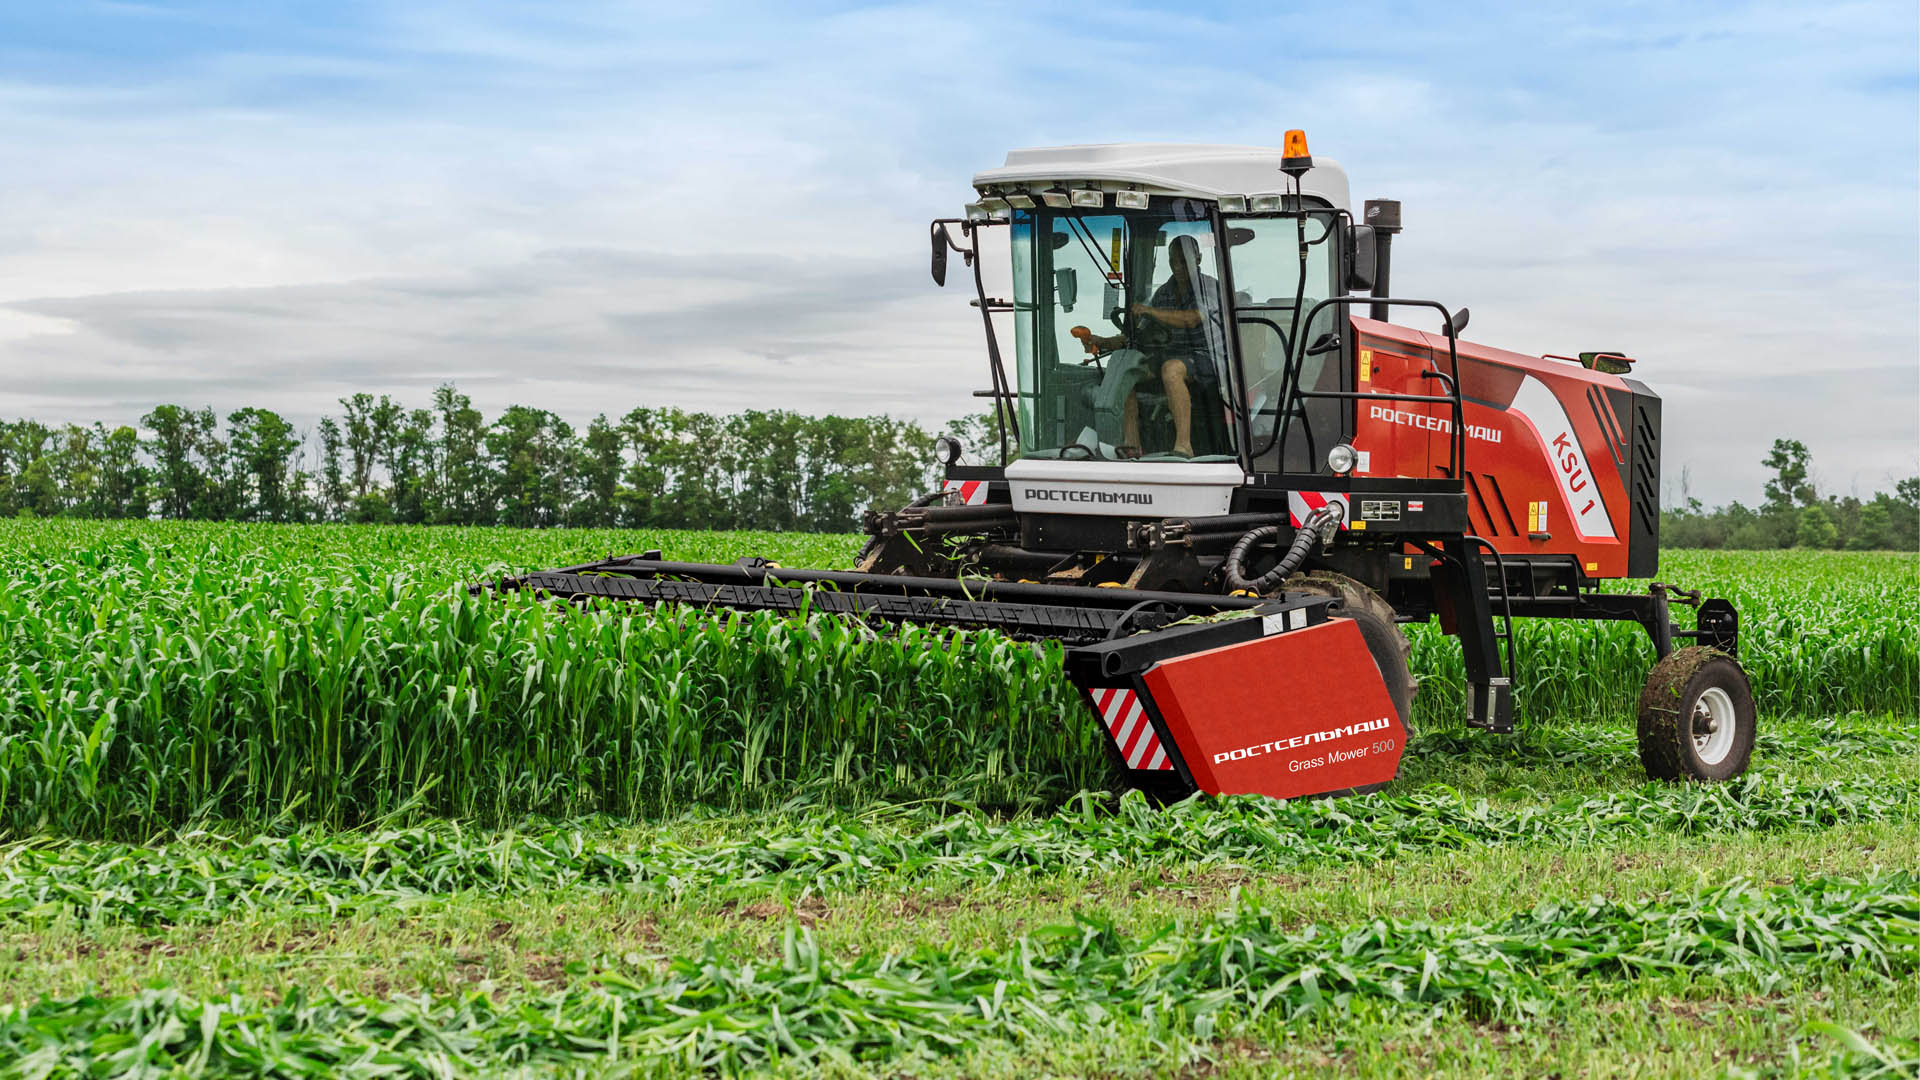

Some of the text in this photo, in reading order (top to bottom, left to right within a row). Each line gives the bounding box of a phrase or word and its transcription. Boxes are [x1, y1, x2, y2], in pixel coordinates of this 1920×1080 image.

[1552, 431, 1595, 516] KSU 1
[1025, 488, 1153, 505] РОСТСЕЛЬМАШ
[1213, 717, 1390, 765] РОСТСЕЛЬМАШ
[1288, 738, 1395, 773] Grass Mower 500
